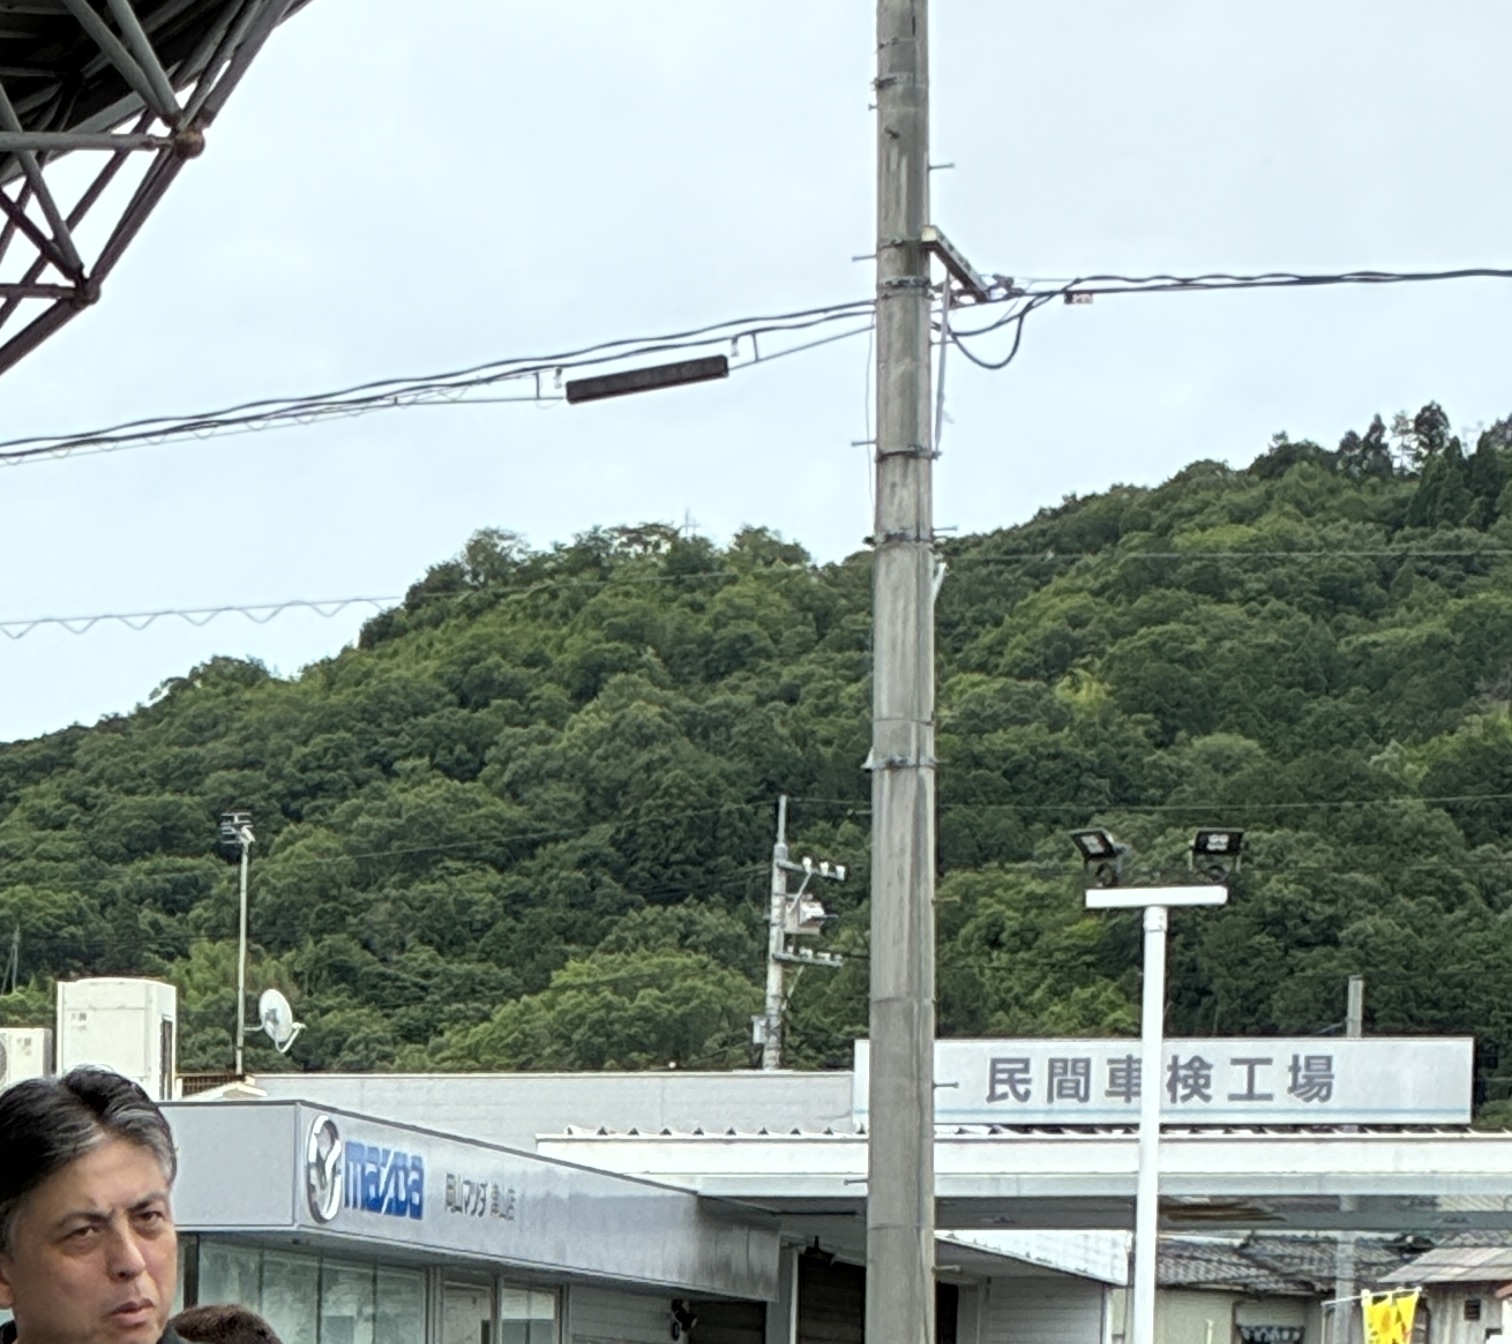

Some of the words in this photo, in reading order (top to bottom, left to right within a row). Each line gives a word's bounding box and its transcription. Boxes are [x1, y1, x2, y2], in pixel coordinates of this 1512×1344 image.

[985, 1054, 1335, 1104] 民間車検工場
[345, 1142, 423, 1220] mazda
